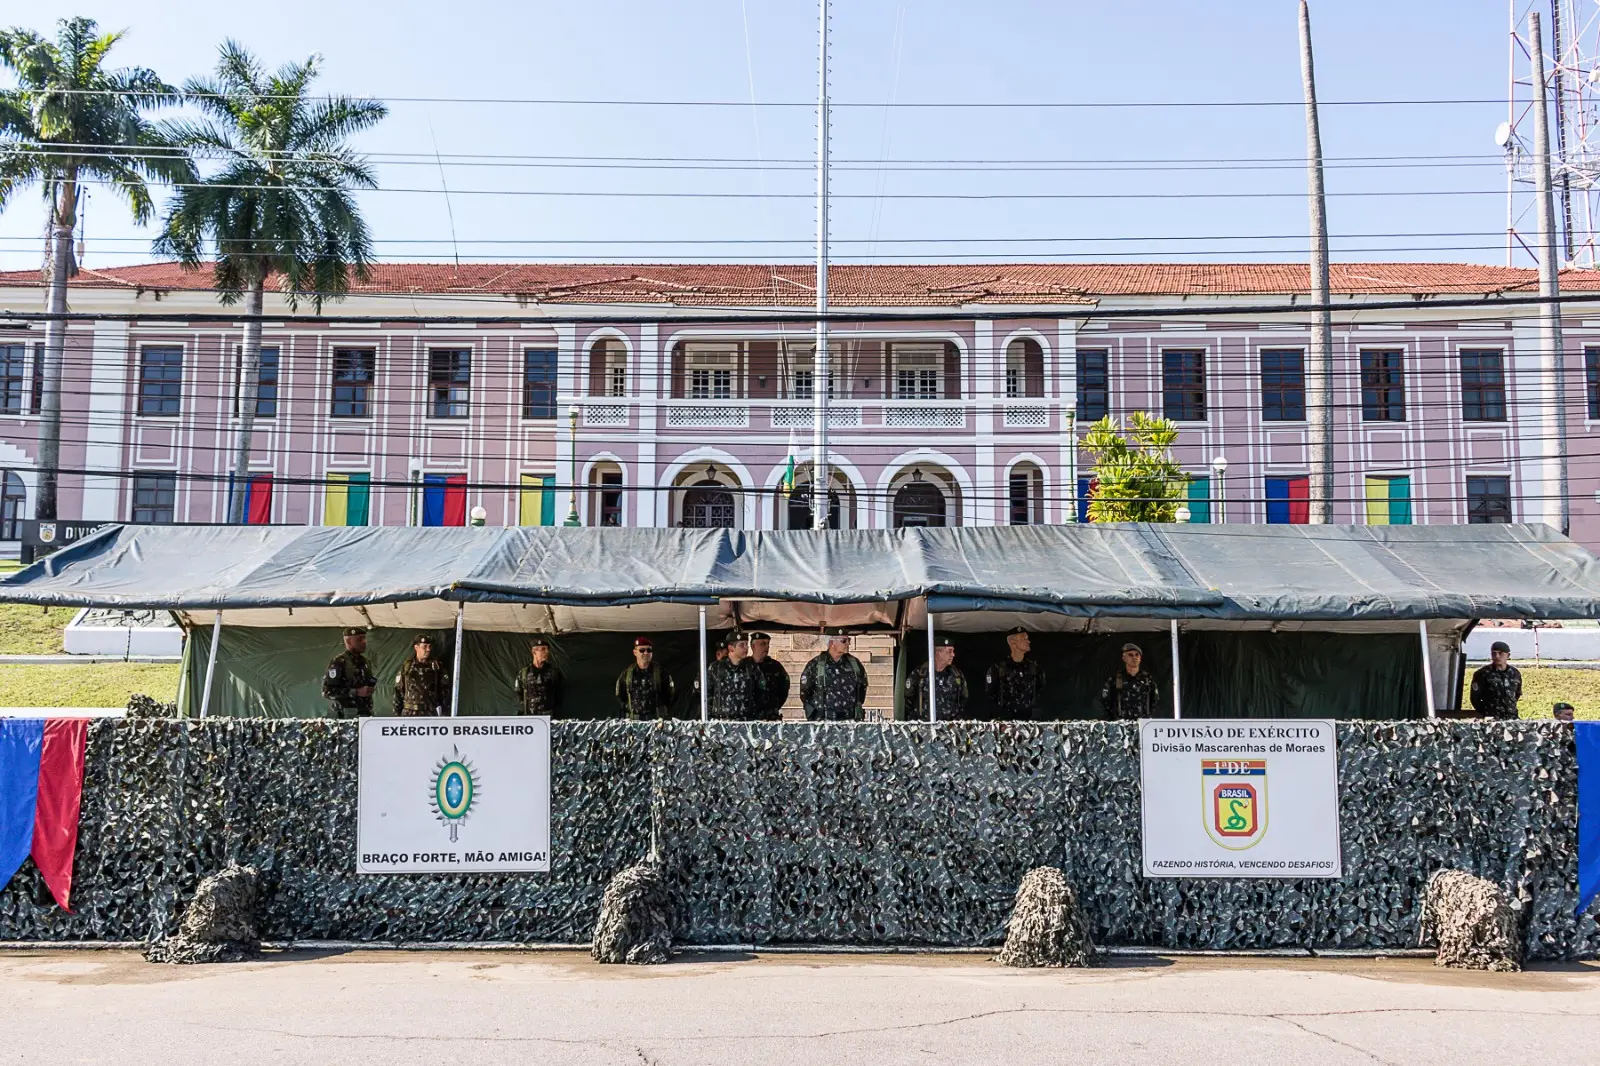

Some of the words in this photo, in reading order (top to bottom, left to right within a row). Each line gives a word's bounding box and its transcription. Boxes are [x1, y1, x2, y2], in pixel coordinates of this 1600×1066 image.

[381, 724, 448, 736] EXÉRCITO
[453, 726, 534, 736] BRASILEIRO
[1153, 728, 1163, 738] 1ª
[1167, 726, 1224, 738] DIVISÃO
[1227, 728, 1245, 738] DE
[1249, 726, 1319, 738] EXÉRCITO
[1153, 743, 1192, 752] Divisão
[1195, 743, 1266, 752] Mascarenhas
[1269, 743, 1282, 752] de
[1286, 743, 1325, 753] Moraes
[363, 853, 408, 865] BRAÇO
[413, 853, 460, 864] FORTE,
[465, 851, 494, 862] MÃO
[498, 852, 546, 862] AMIGA!
[1194, 860, 1236, 869] HISTÓRIA,
